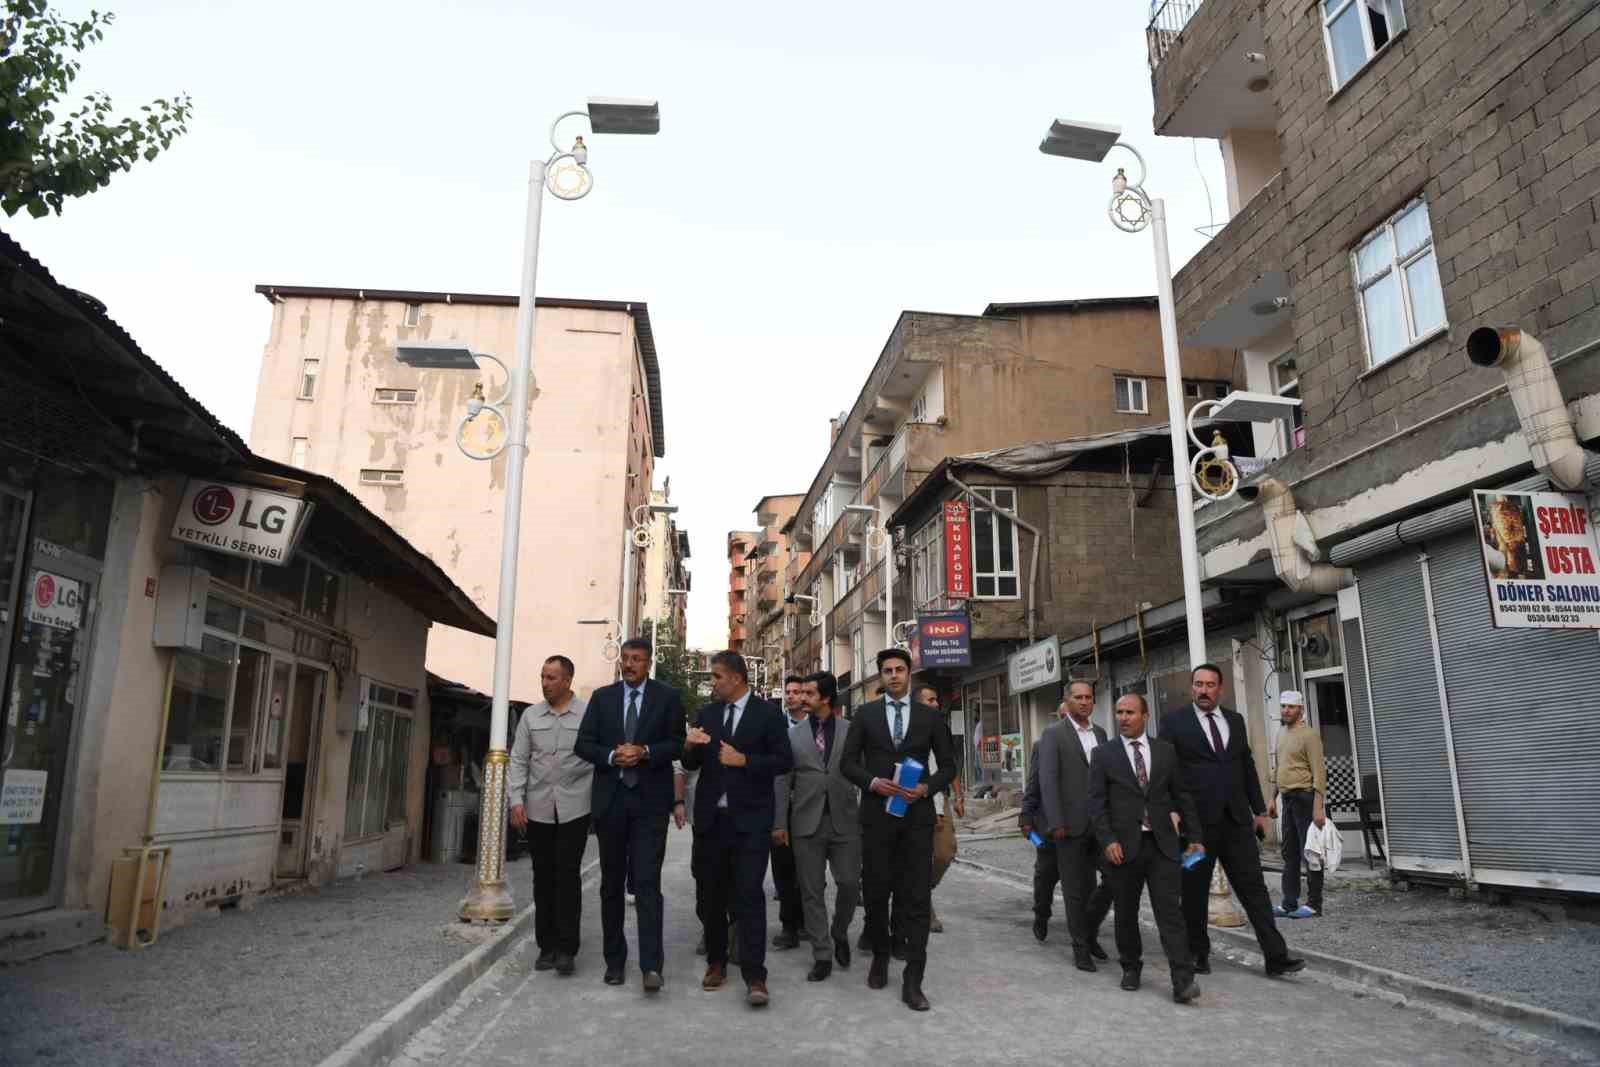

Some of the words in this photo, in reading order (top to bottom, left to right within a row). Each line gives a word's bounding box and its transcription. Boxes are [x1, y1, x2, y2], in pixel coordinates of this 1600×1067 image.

[238, 499, 288, 534] LG
[1536, 502, 1587, 540] ŞERİF
[178, 526, 228, 547] YETKİLİ
[231, 540, 282, 560] SERVİSİ
[1545, 546, 1596, 575] USTA
[57, 586, 77, 608] LG
[1497, 581, 1544, 602] DÖNER
[1546, 585, 1600, 602] SALONU
